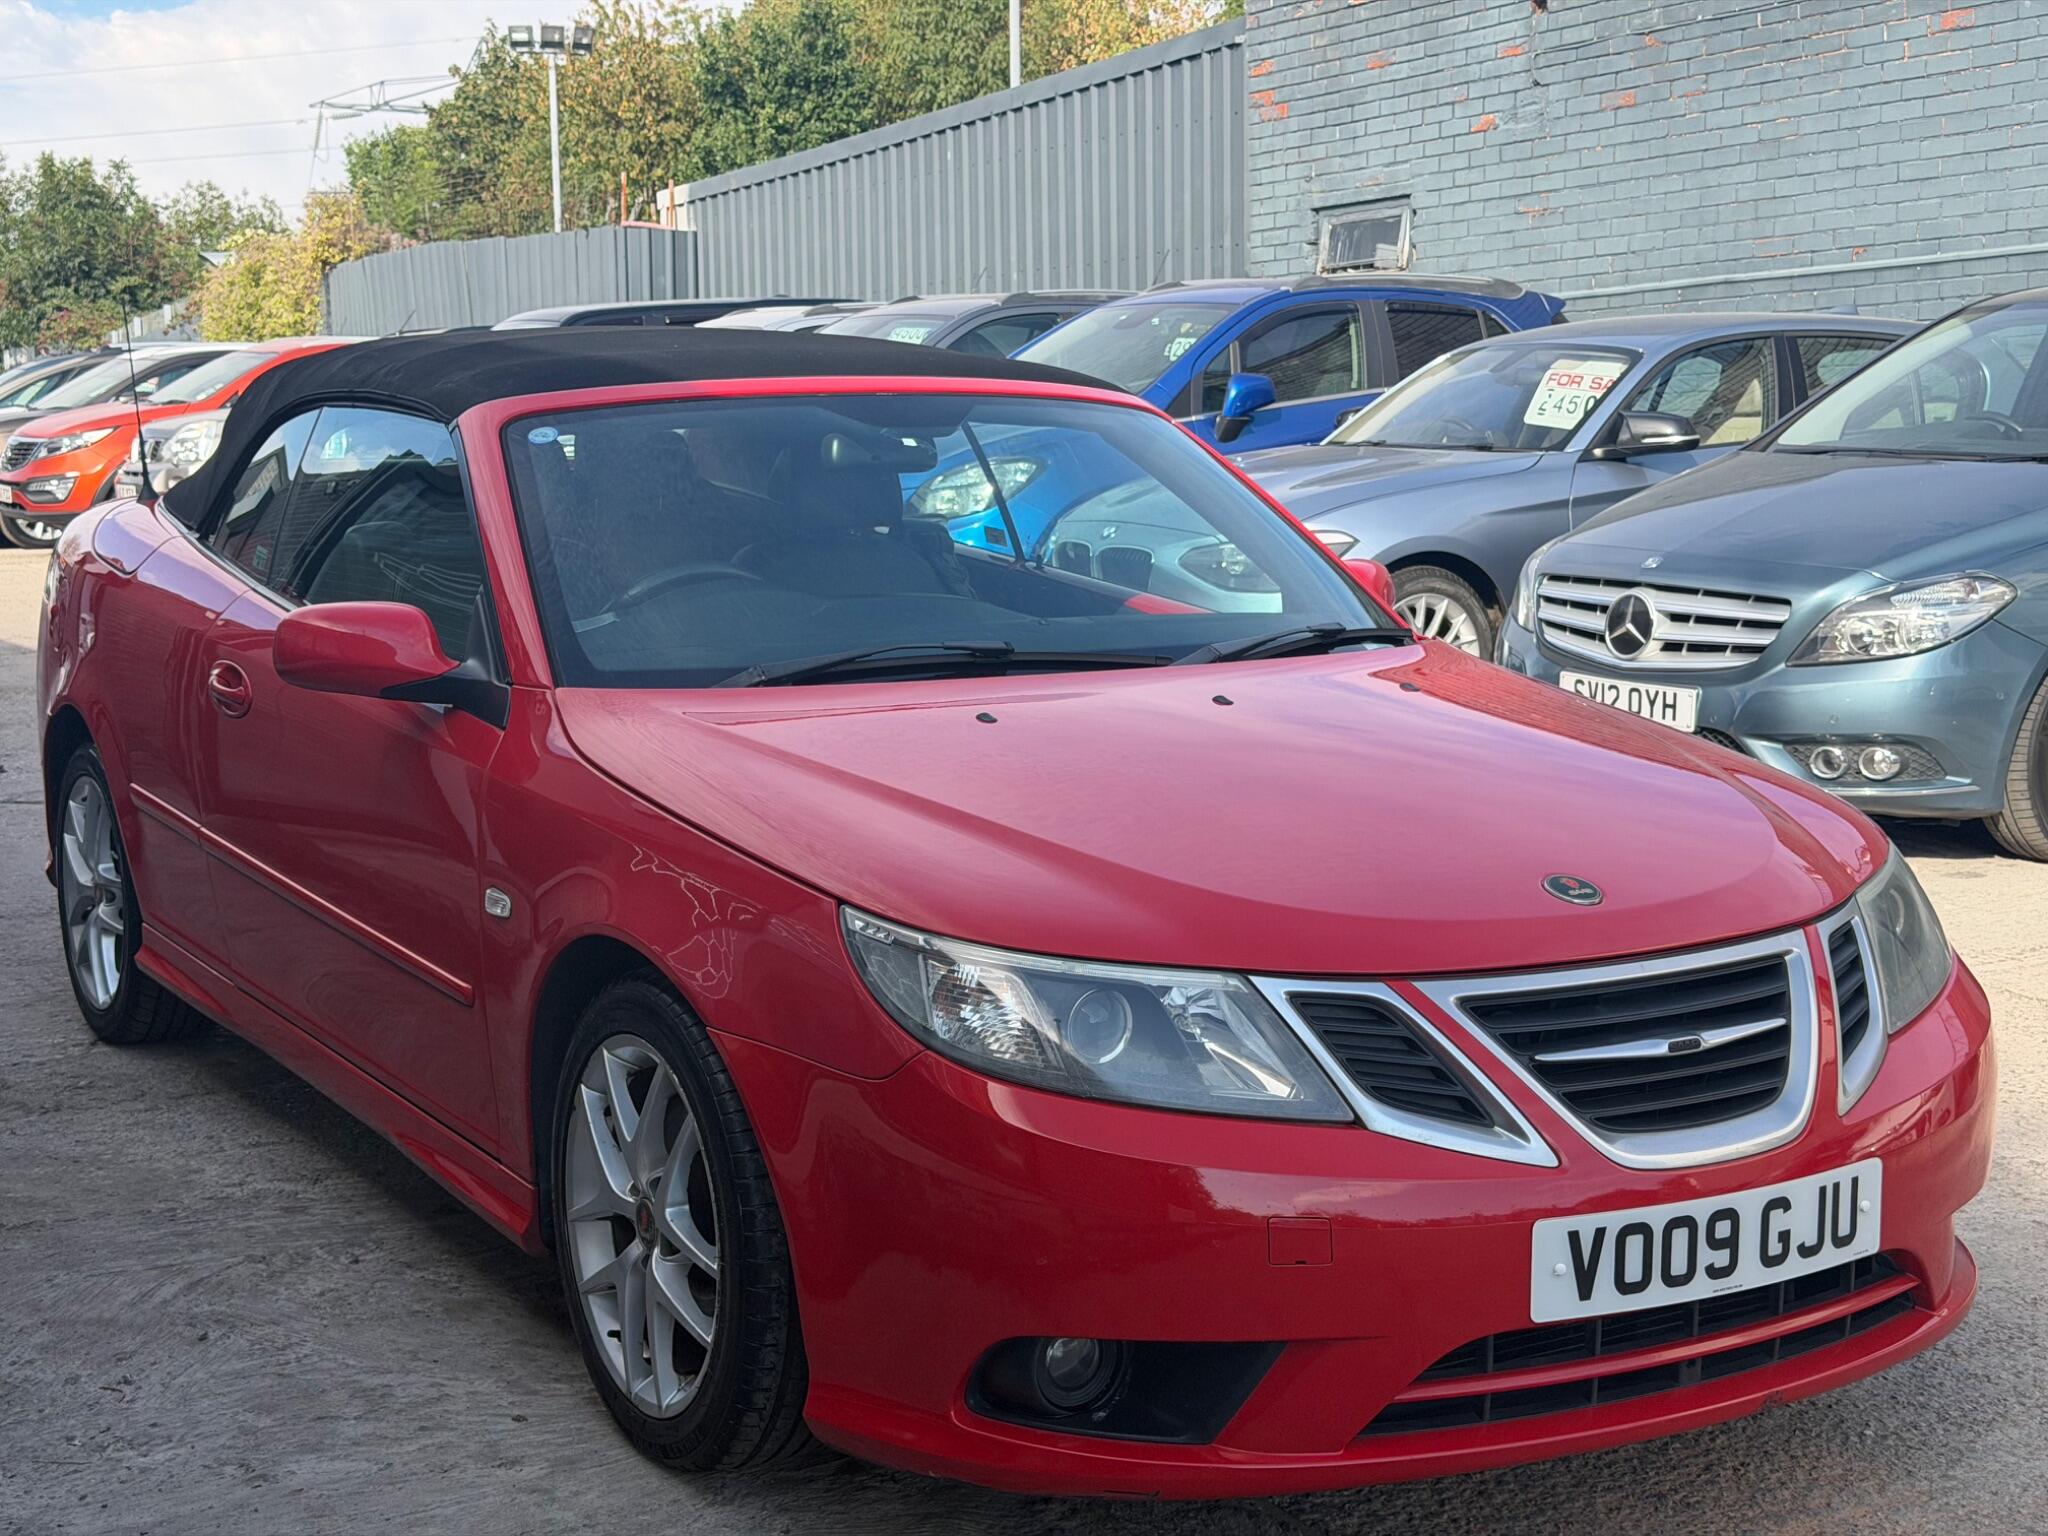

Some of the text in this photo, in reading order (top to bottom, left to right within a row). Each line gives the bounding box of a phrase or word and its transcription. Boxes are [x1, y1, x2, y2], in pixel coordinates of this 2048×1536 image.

[1546, 373, 1584, 388] FOR
[1574, 679, 1620, 707] SV12
[1567, 1175, 1859, 1302] VO09 GJU
